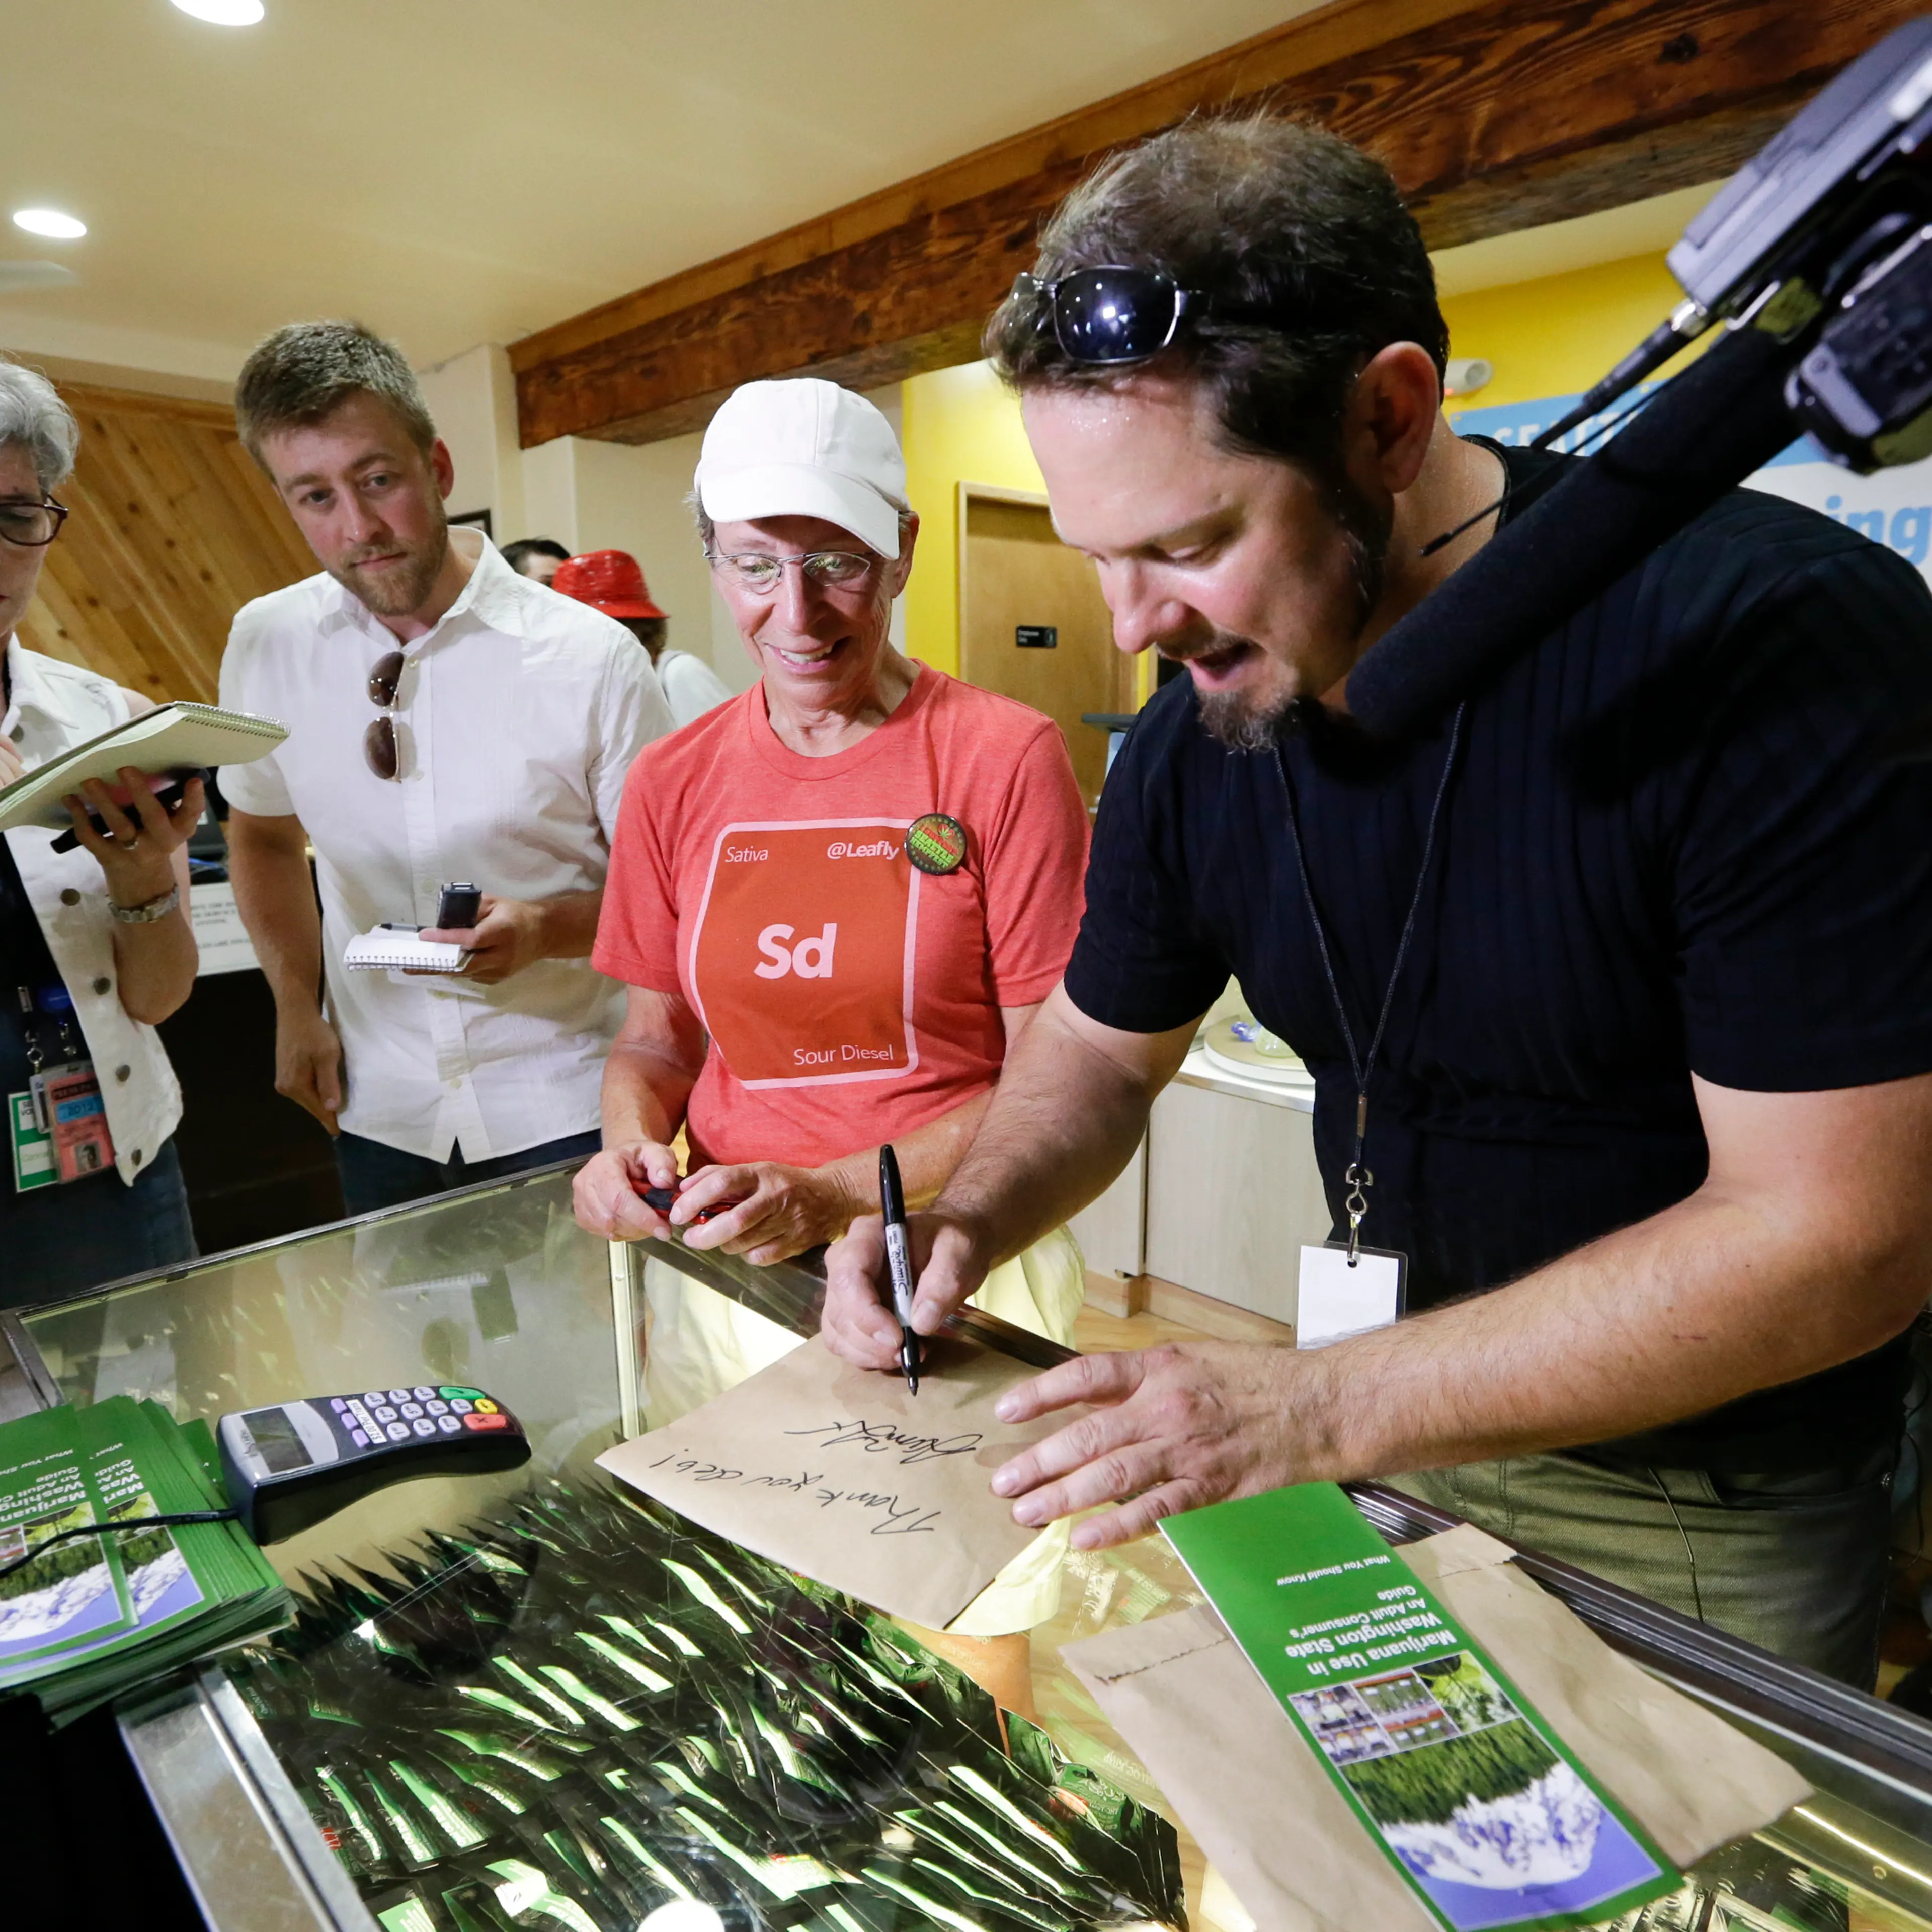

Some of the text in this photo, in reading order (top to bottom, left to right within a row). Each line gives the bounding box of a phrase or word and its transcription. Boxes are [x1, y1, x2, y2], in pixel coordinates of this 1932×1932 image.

[725, 846, 768, 863] Sativa
[827, 841, 899, 861] @Leafly
[914, 830, 954, 862] SEATTLE
[753, 923, 837, 979] Sd
[793, 1045, 893, 1065] Sour Diesel
[366, 1425, 382, 1440] $2.00
[45, 1448, 73, 1461] What
[96, 1442, 123, 1457] What
[21, 1459, 42, 1468] You
[115, 1465, 134, 1476] An
[36, 1467, 78, 1482] Guide
[17, 1473, 80, 1497] An Adult
[817, 1489, 941, 1534] Thank
[1277, 1555, 1390, 1586] What You Should Know
[1377, 1585, 1416, 1601] Guide
[1289, 1598, 1426, 1638] An Adult Consumer's
[1285, 1611, 1442, 1658] Washington State
[1307, 1629, 1457, 1676] Marijuana Use in
